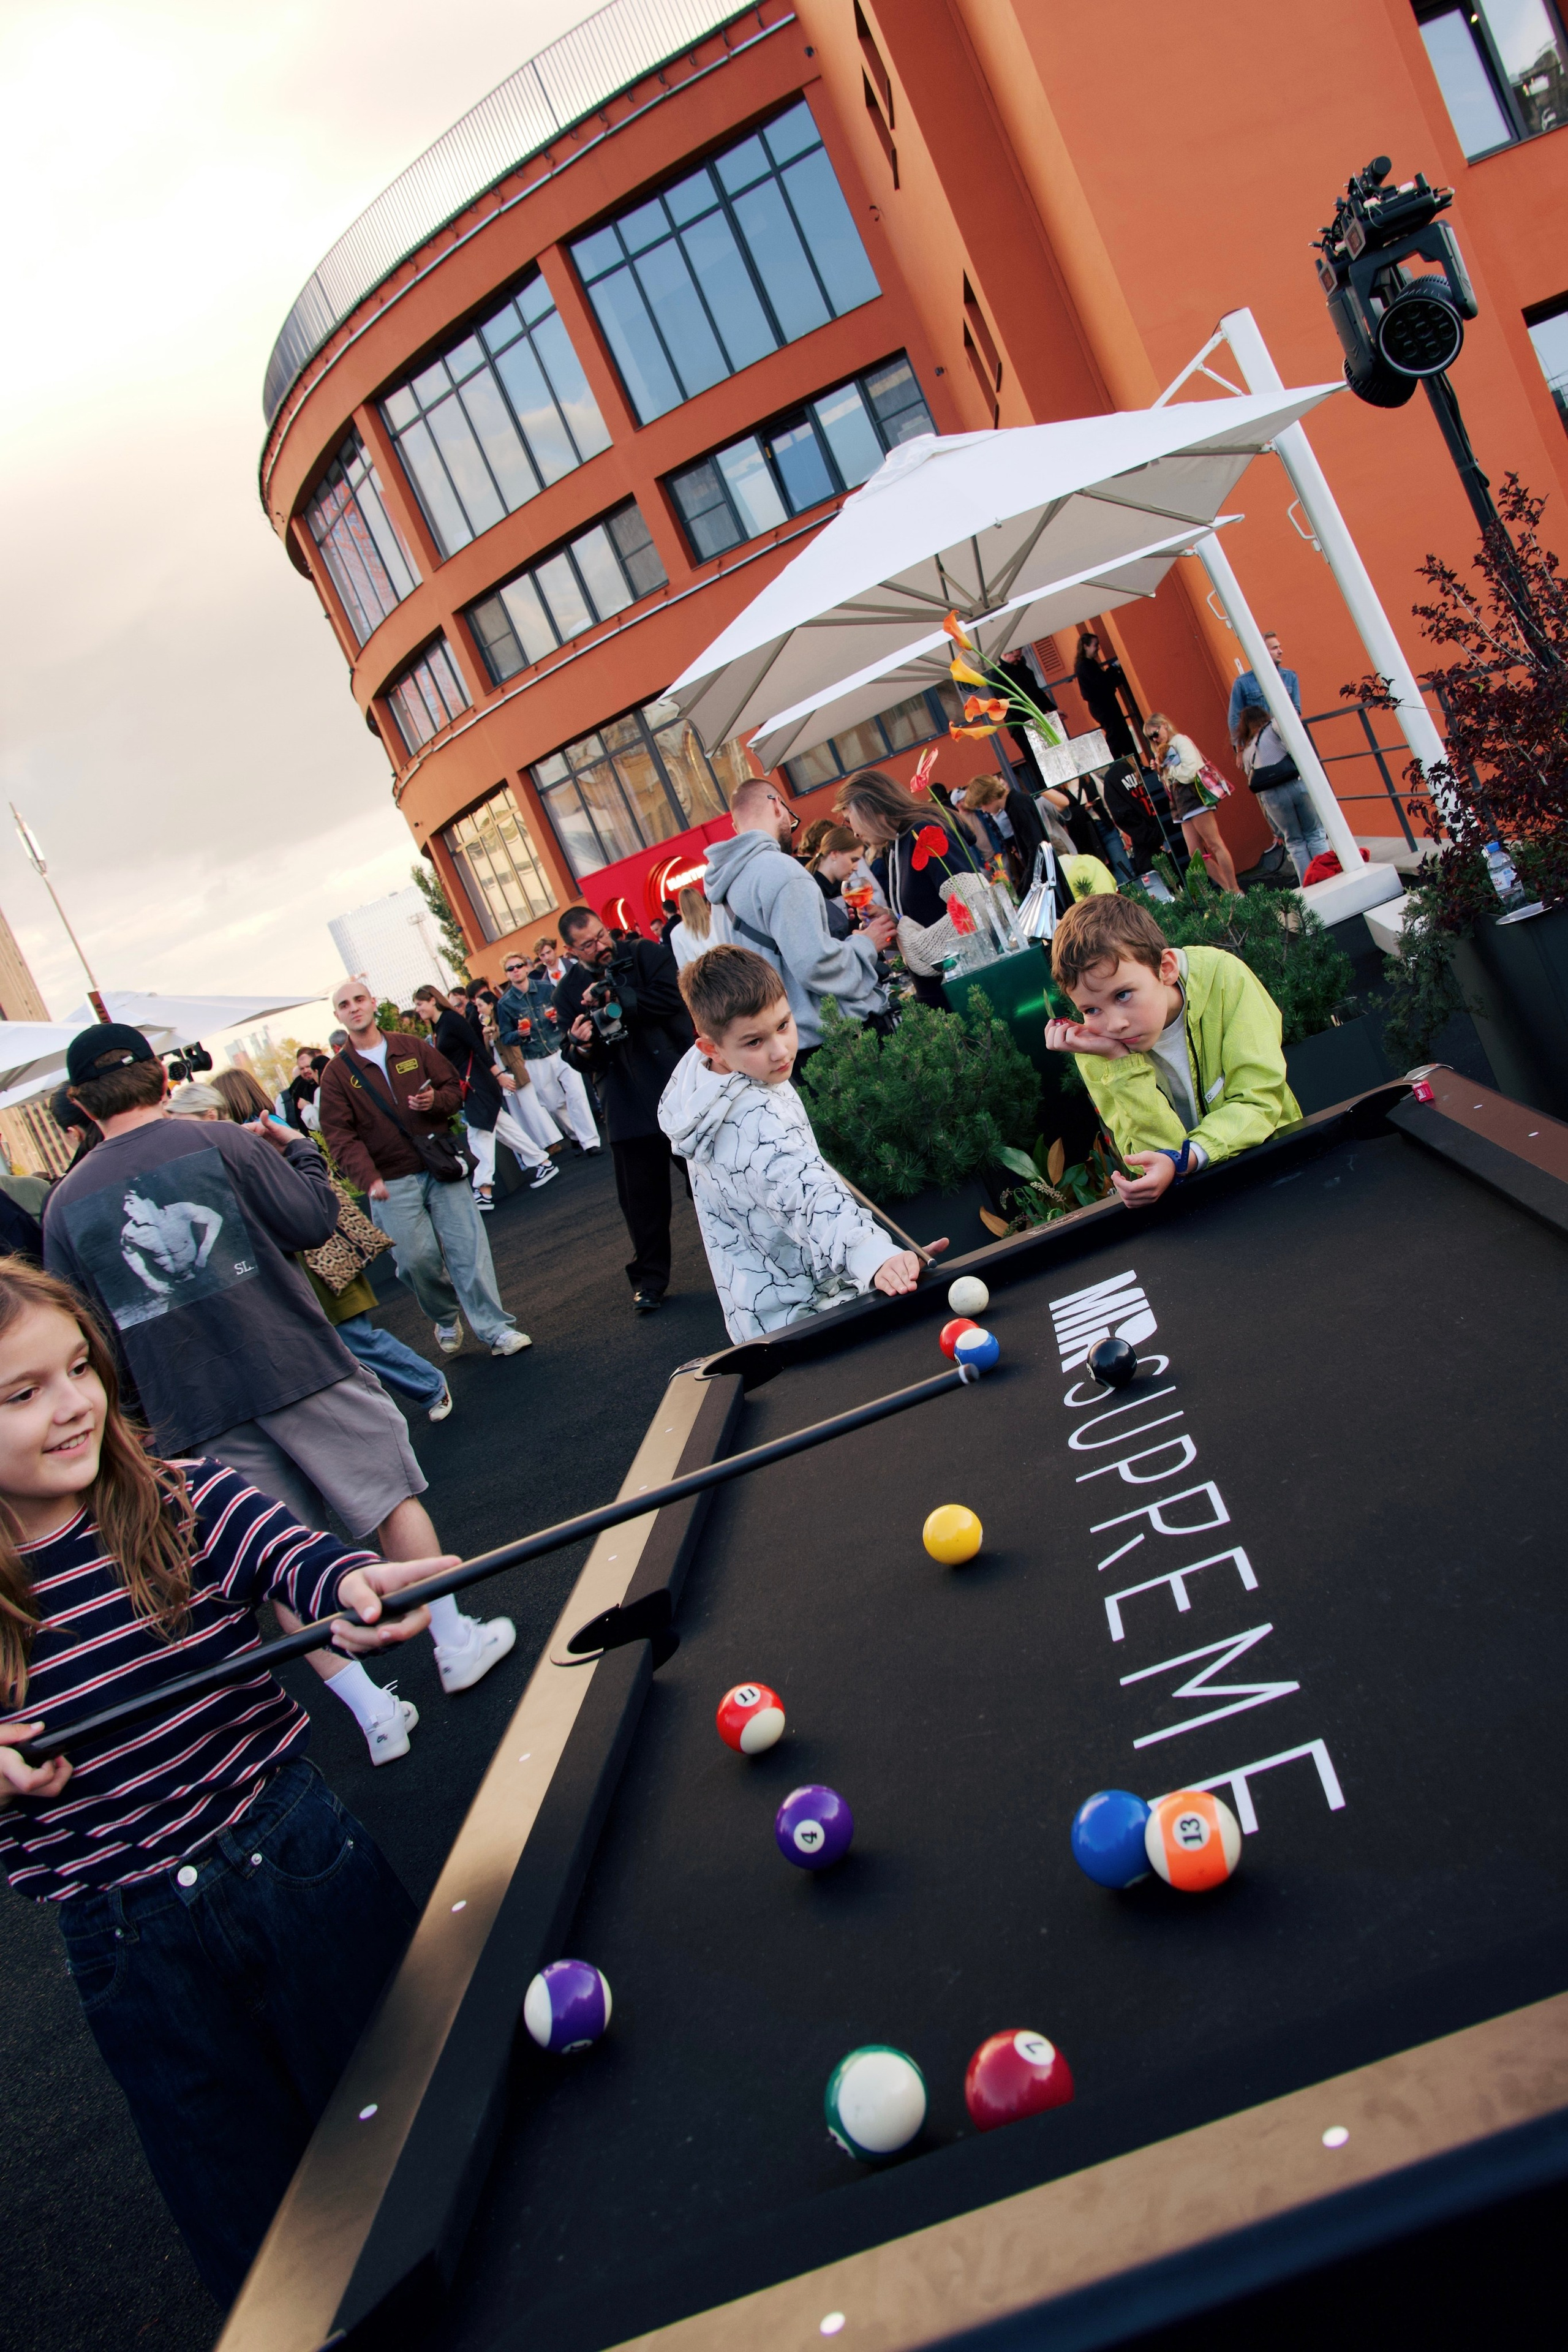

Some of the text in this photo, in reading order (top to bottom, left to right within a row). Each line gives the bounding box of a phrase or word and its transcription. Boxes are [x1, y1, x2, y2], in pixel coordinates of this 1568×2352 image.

[739, 1688, 756, 1703] 11
[801, 1831, 817, 1844] 4
[1180, 1818, 1203, 1844] 13
